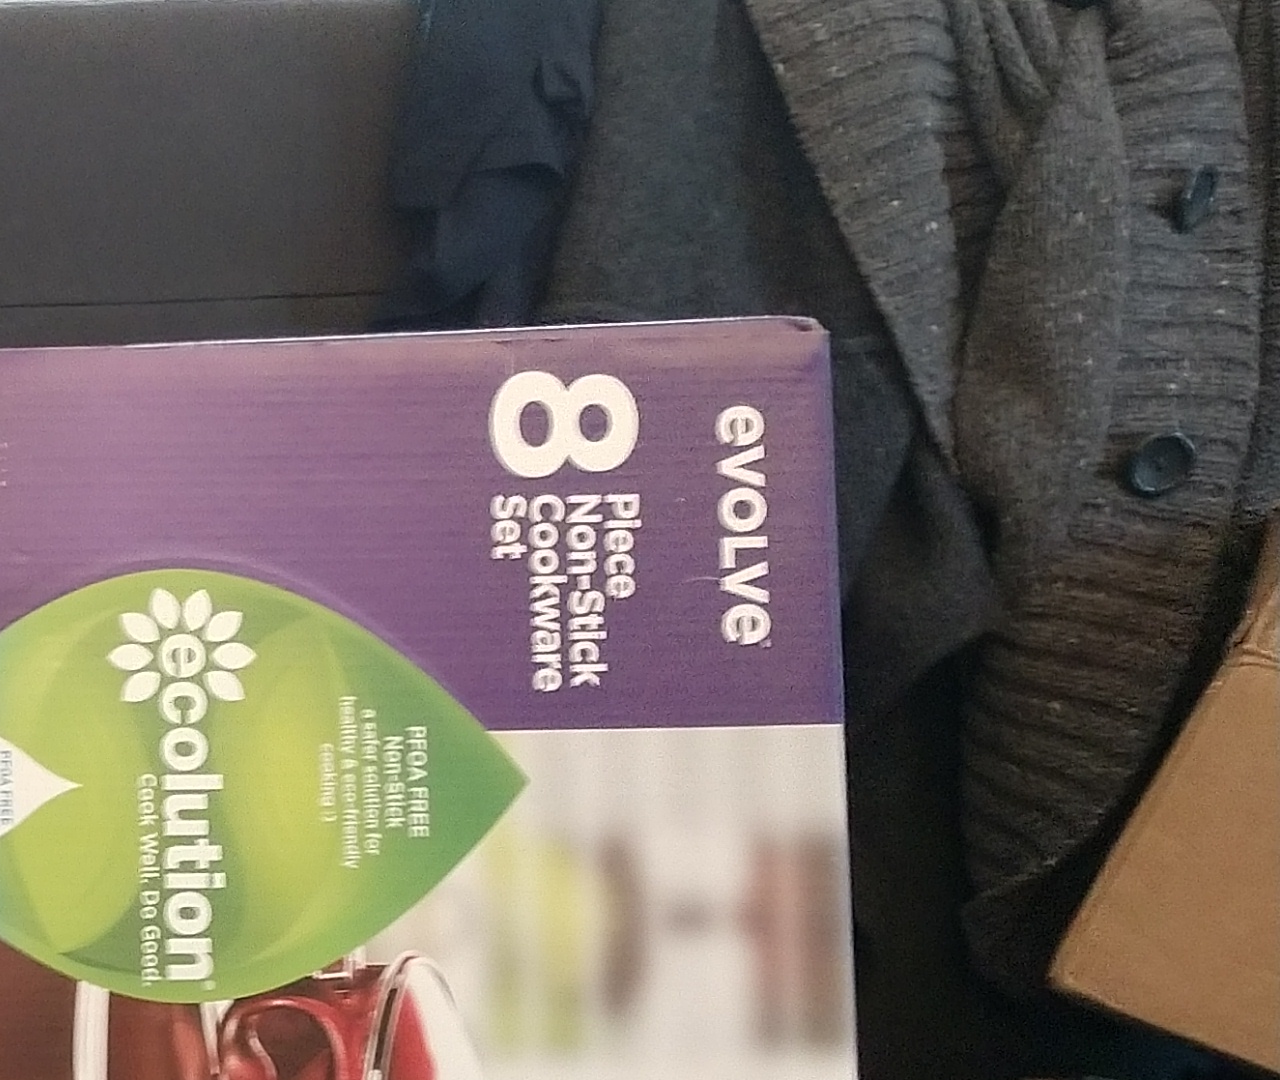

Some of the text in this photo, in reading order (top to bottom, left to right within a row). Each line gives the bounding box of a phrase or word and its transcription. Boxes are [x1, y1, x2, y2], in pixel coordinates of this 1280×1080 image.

[488, 371, 640, 478] 8
[489, 494, 528, 560] Set
[602, 494, 642, 600] Piece
[526, 494, 568, 691] Cookware
[564, 494, 608, 688] Non-Stick
[317, 743, 337, 806] cooking
[337, 696, 358, 754] healthy
[157, 633, 226, 982] ecolution
[338, 774, 360, 869] eco-friendly
[359, 709, 382, 856] a safer solution for
[382, 736, 406, 828] Non-Stick
[404, 726, 430, 838] PFOA FREE
[136, 774, 162, 986] Cook Well. Do Good.
